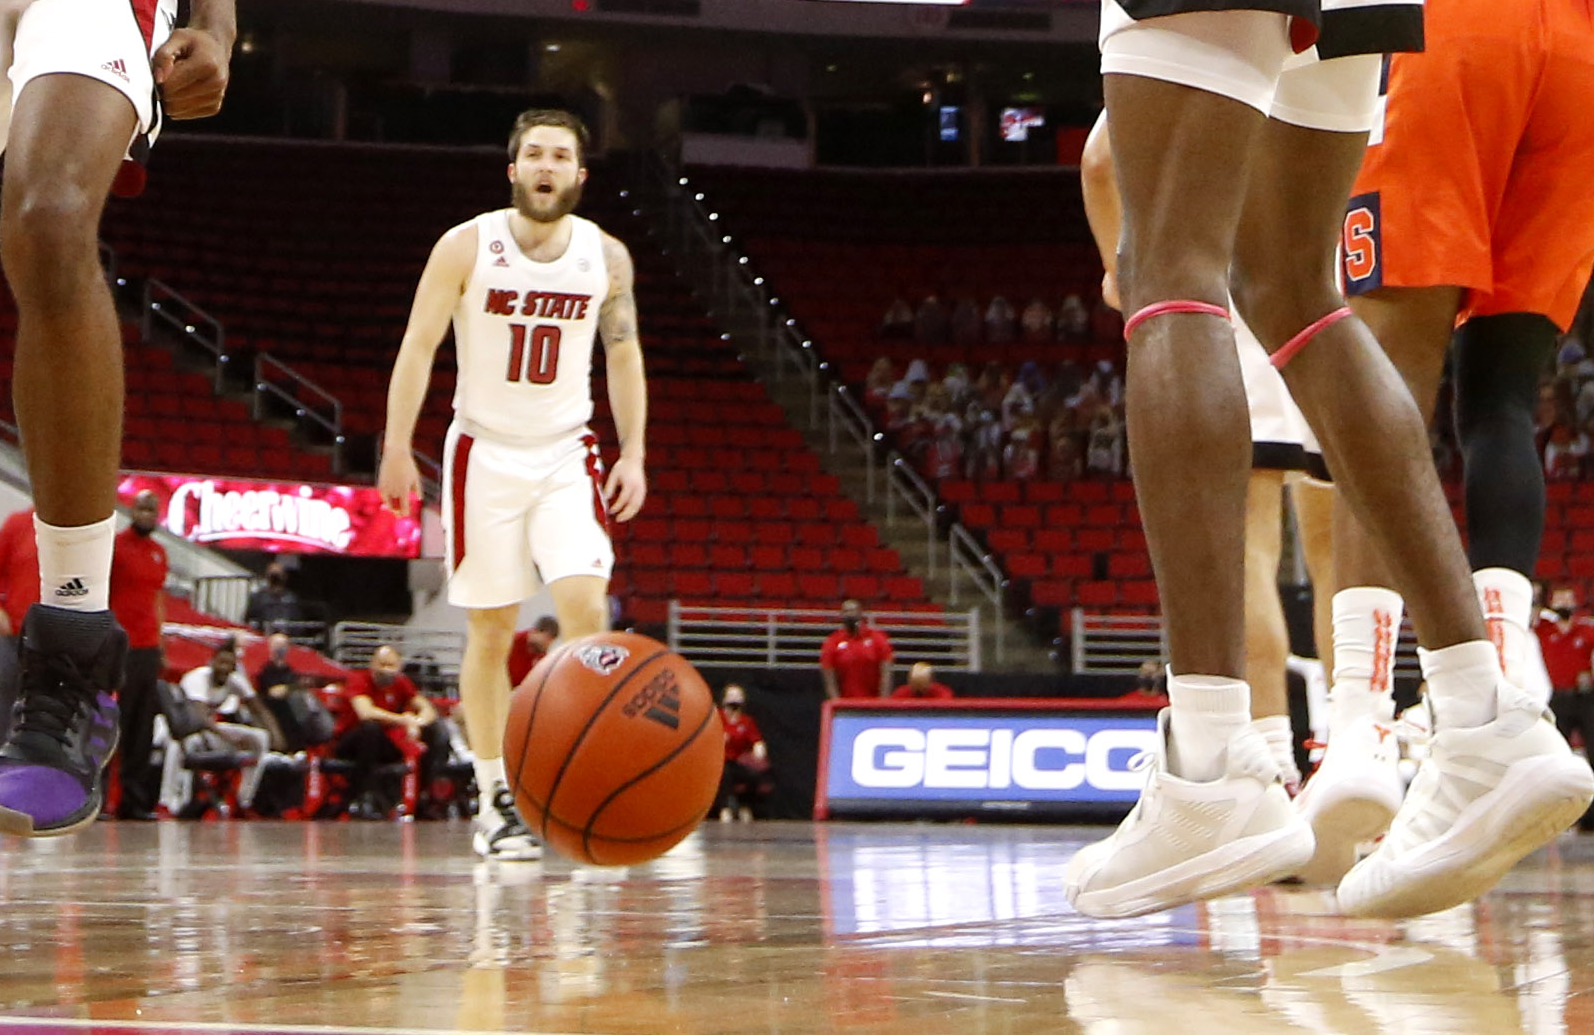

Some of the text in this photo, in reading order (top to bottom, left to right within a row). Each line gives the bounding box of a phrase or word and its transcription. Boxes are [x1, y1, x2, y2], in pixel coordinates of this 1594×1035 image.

[1342, 206, 1376, 283] S
[484, 287, 594, 320] NC STATE
[506, 322, 562, 385] 10
[166, 480, 356, 550] Cheerwine
[851, 726, 1162, 790] GEICO
